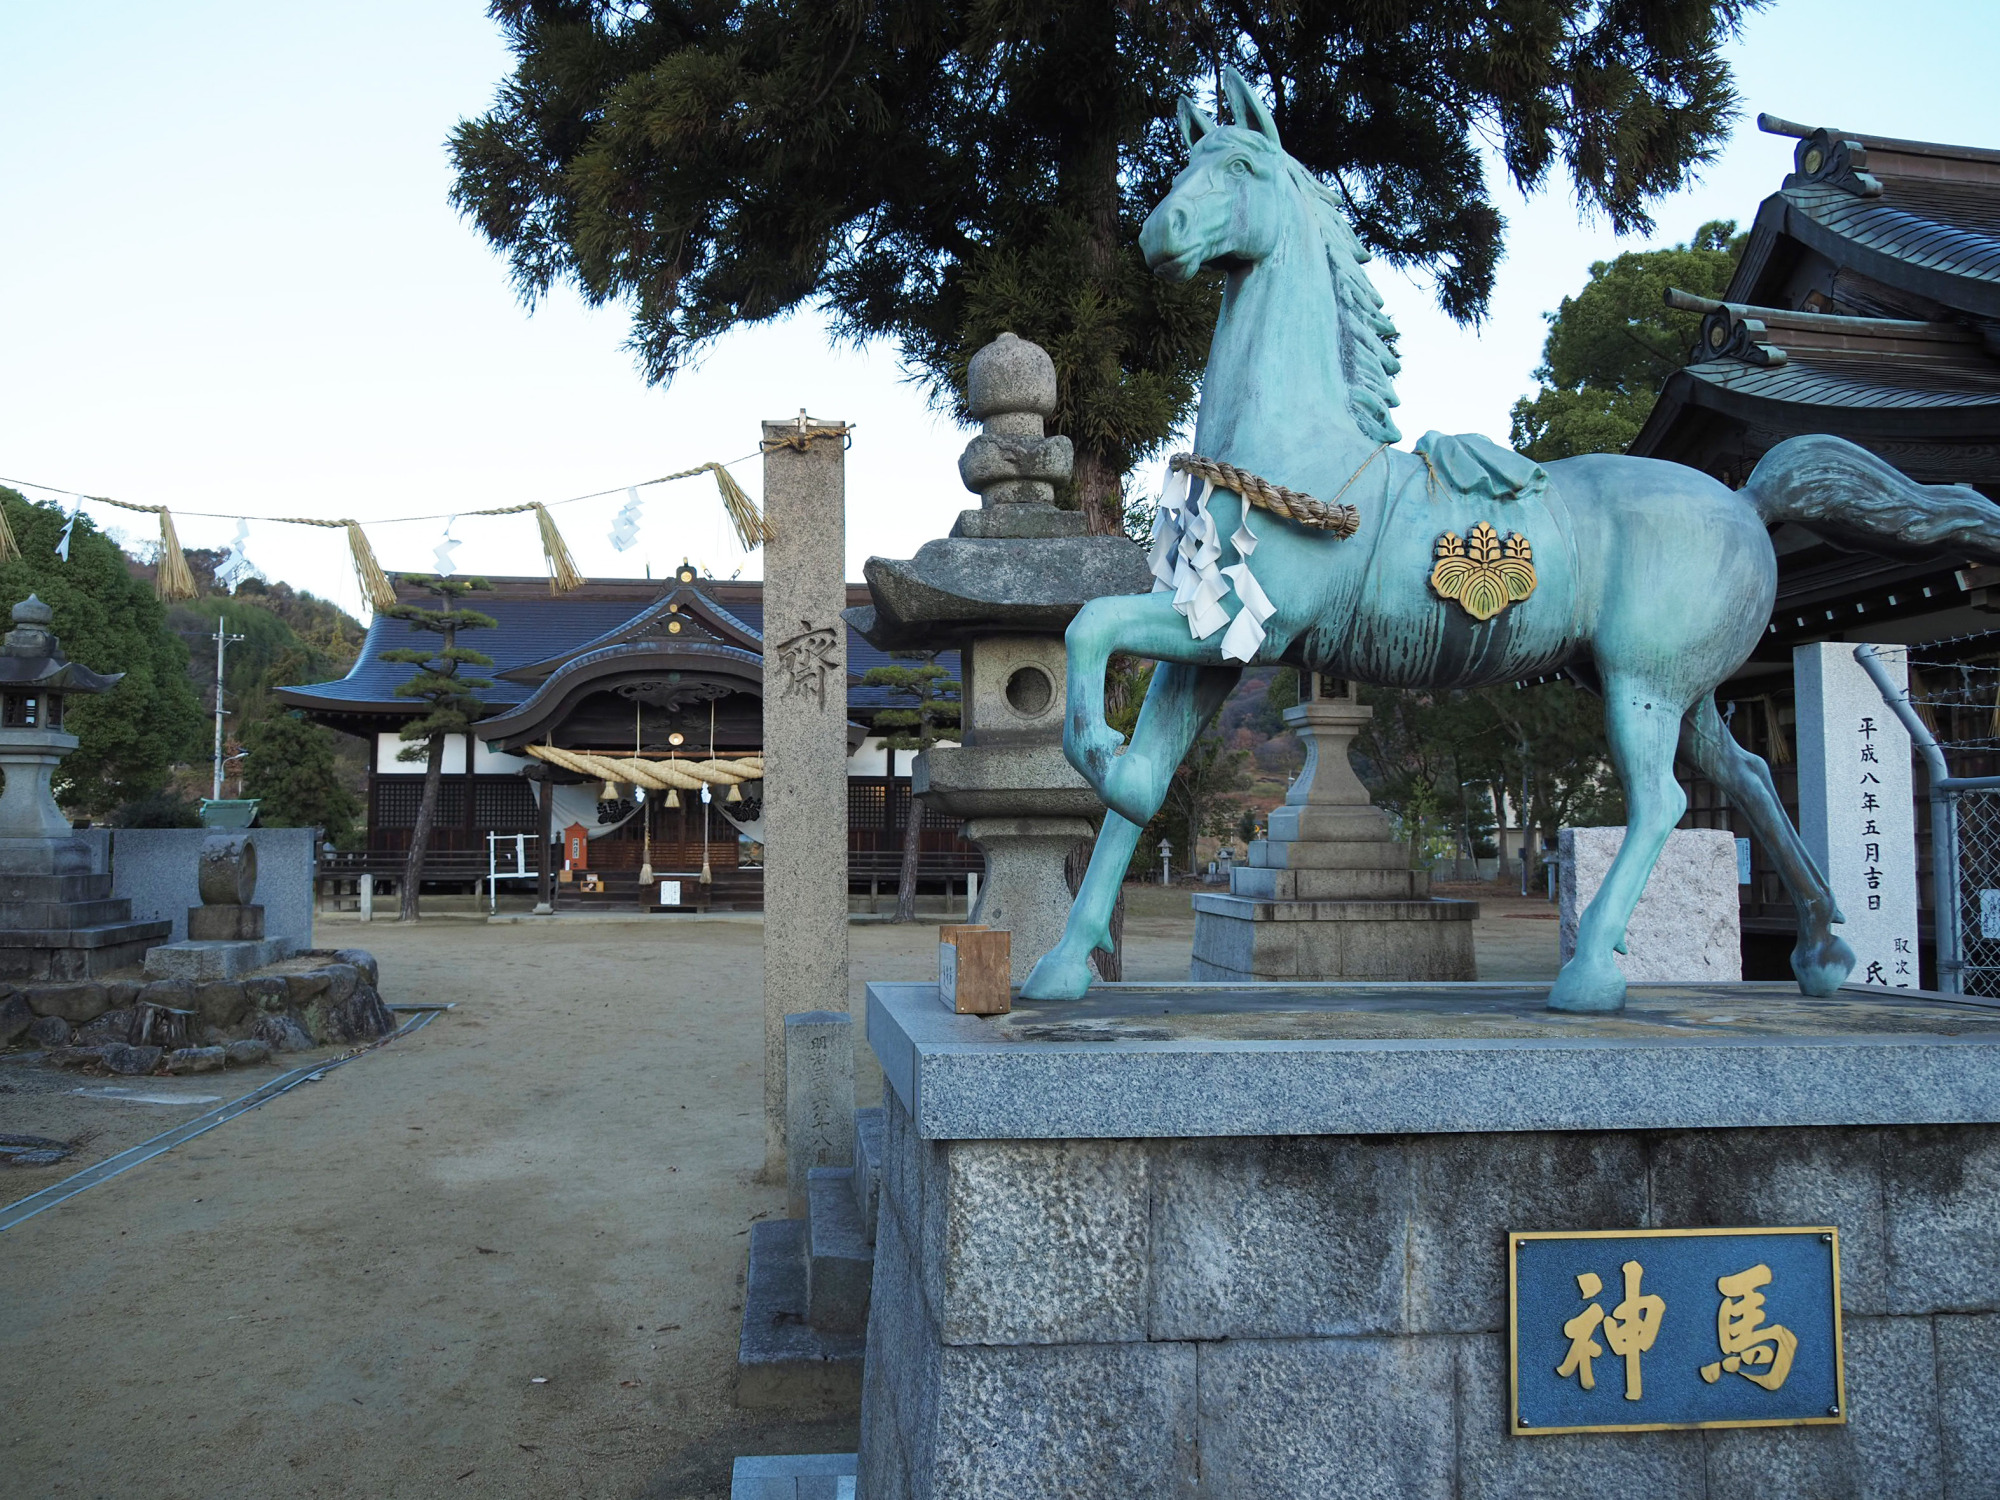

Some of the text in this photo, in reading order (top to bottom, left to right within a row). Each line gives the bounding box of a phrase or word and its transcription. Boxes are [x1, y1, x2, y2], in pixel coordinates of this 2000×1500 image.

[1858, 717, 1883, 911] 平成八年五月吉日
[1556, 1260, 1798, 1401] 神馬
